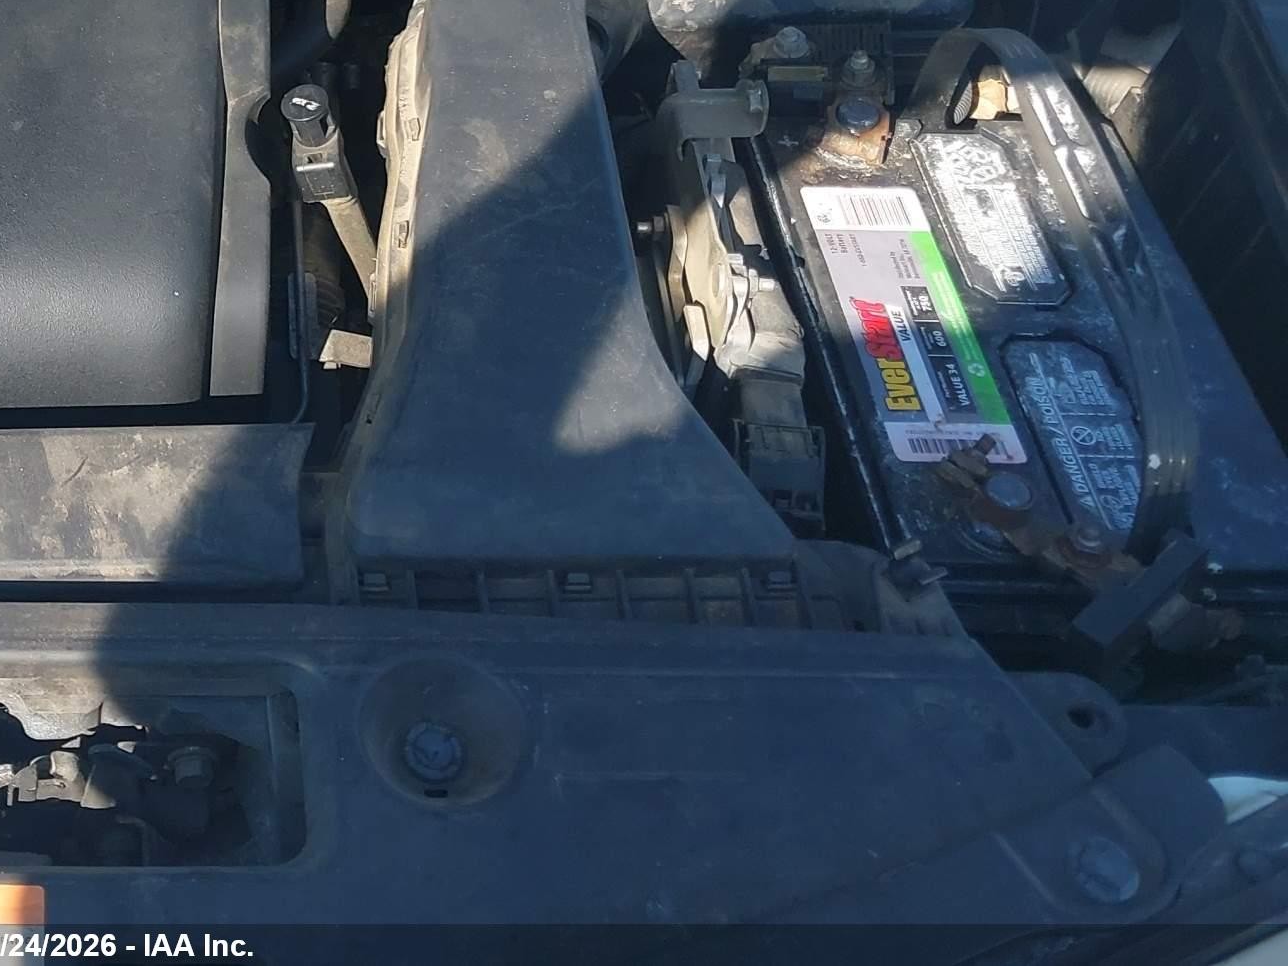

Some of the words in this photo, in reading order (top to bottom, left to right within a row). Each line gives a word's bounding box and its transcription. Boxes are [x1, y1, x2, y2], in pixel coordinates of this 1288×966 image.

[891, 310, 912, 342] VALUE
[932, 330, 946, 347] 600
[945, 363, 958, 376] 34
[951, 377, 971, 407] VALUE
[1025, 376, 1059, 425] POISON
[1053, 436, 1089, 494] DANGER
